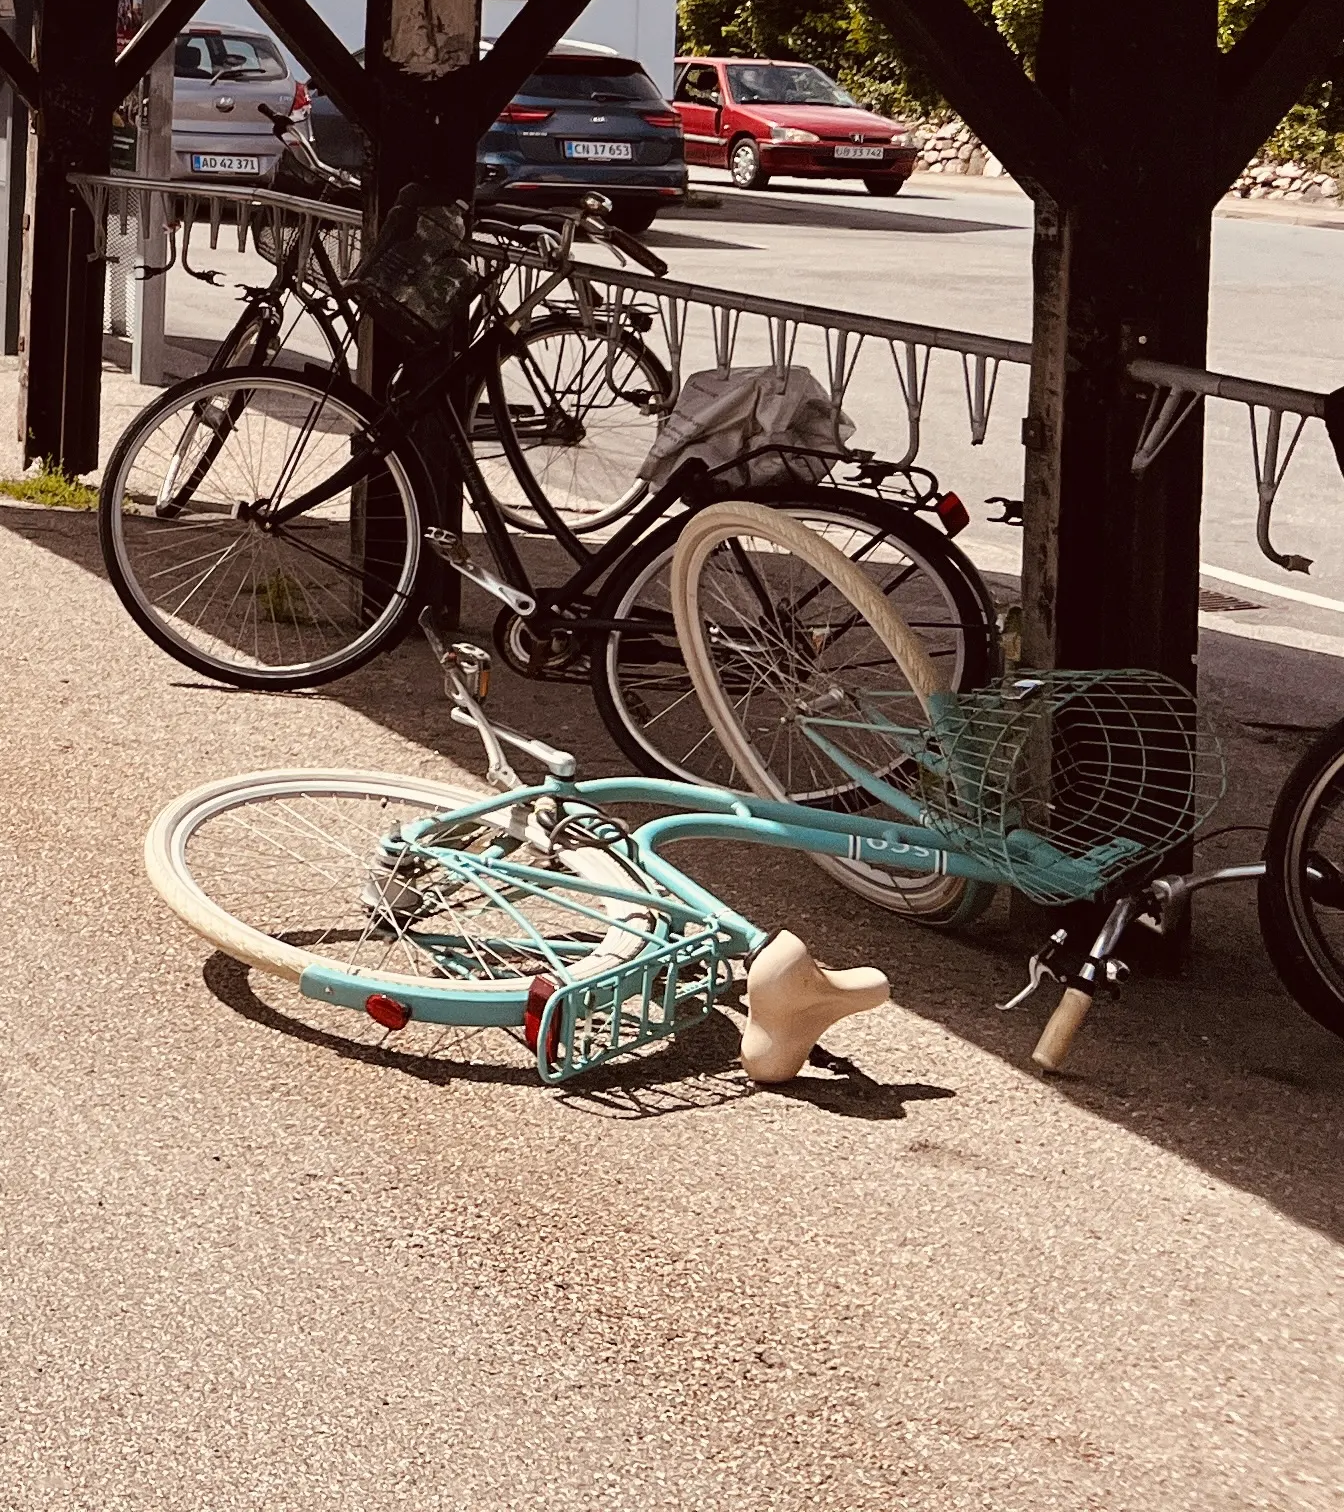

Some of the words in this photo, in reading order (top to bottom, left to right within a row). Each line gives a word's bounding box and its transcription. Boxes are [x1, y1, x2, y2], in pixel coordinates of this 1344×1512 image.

[574, 143, 590, 155] CN
[593, 144, 606, 156] 17
[608, 144, 630, 156] 653
[202, 157, 217, 169] AD
[220, 158, 234, 170] 42
[236, 158, 256, 170] 371
